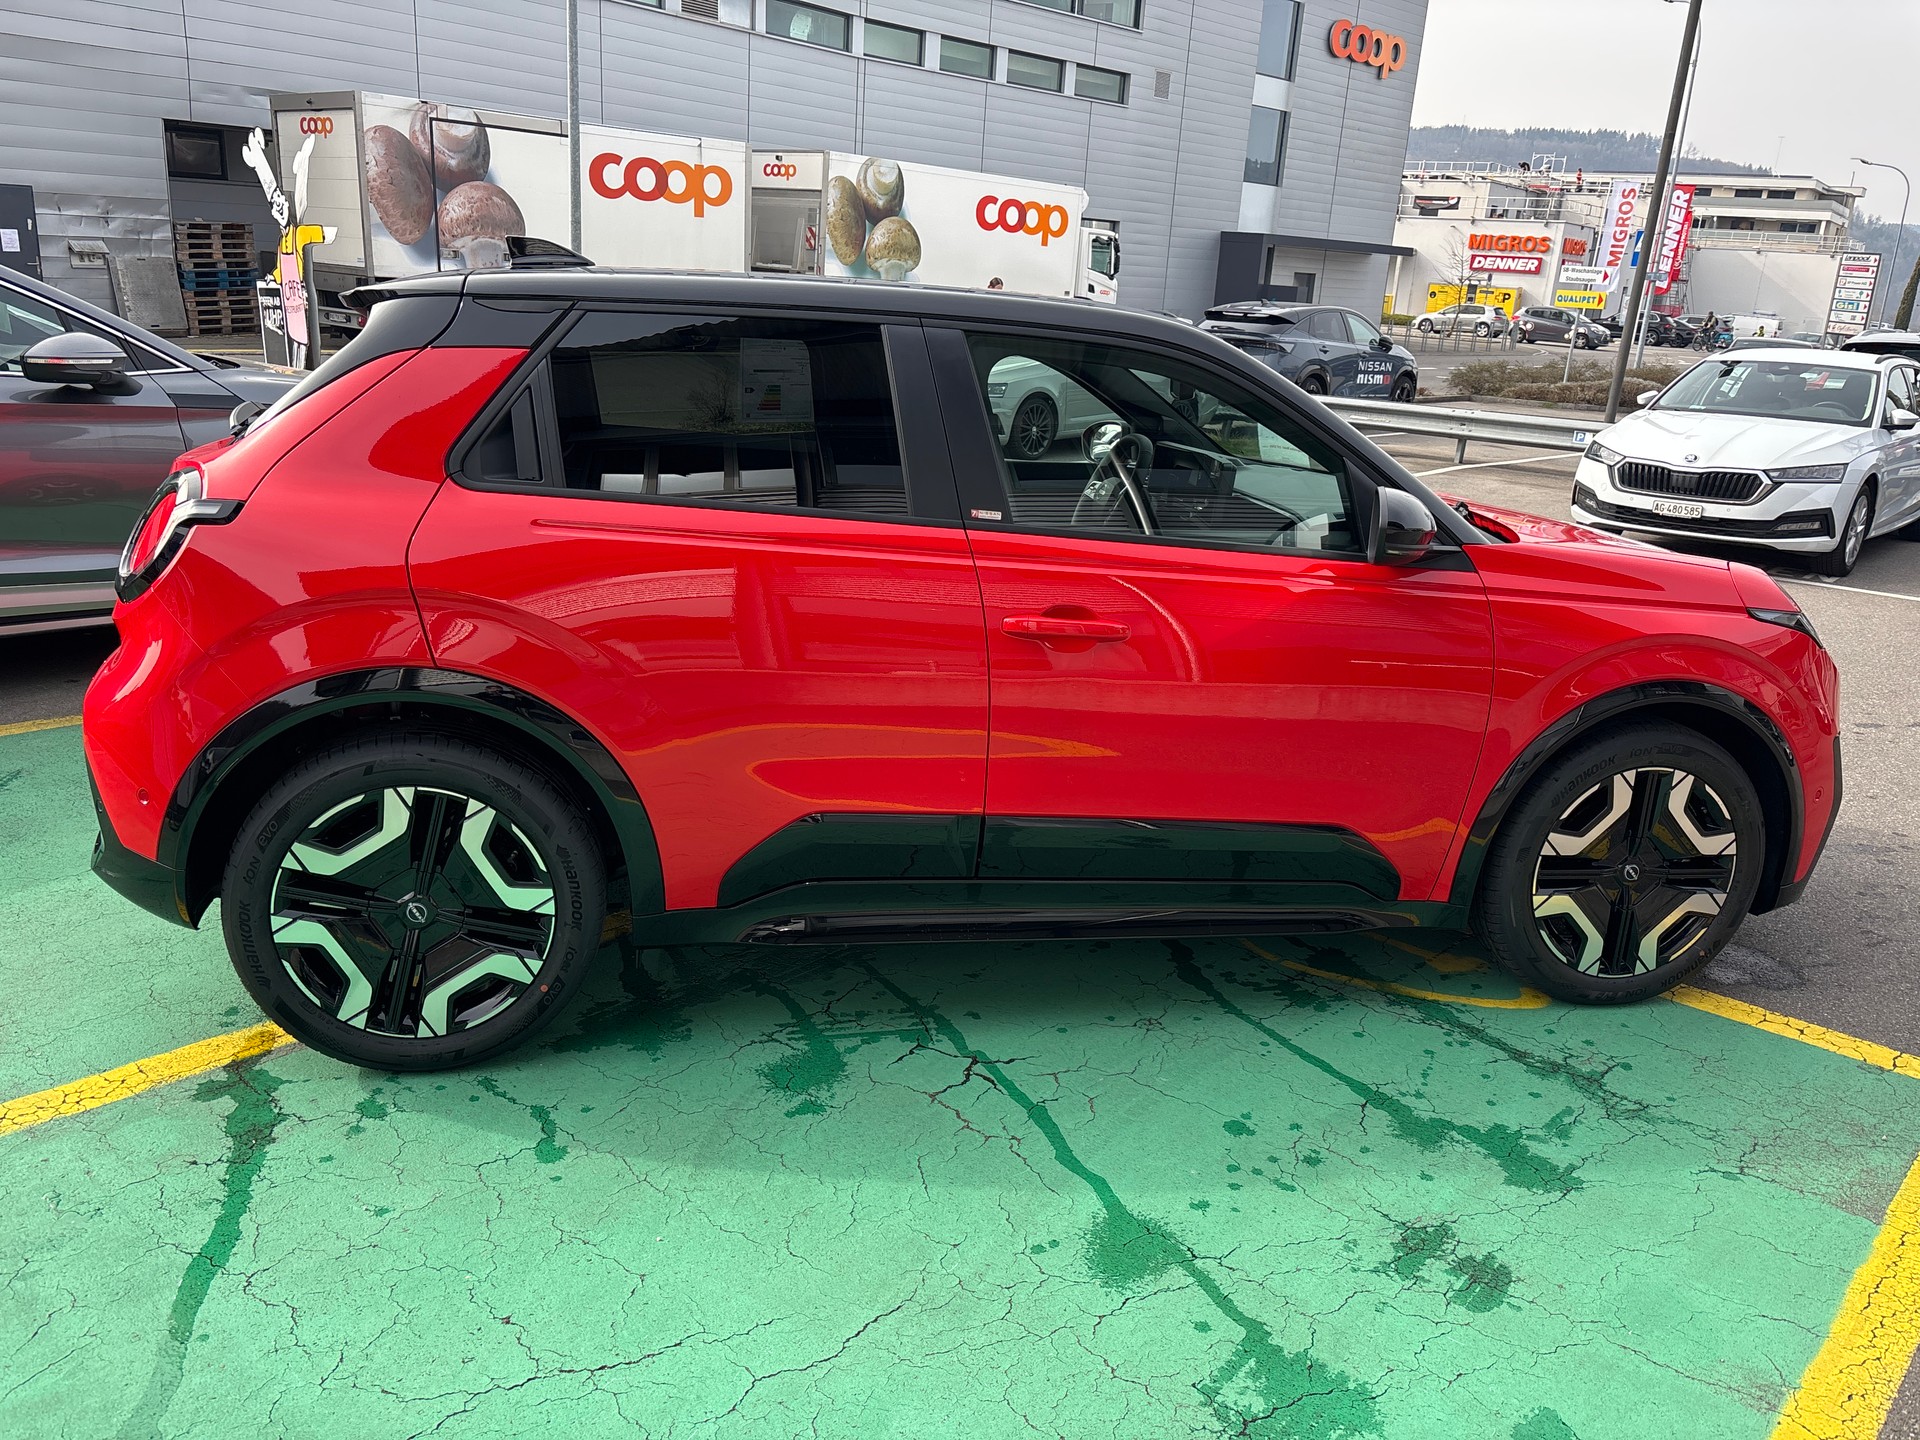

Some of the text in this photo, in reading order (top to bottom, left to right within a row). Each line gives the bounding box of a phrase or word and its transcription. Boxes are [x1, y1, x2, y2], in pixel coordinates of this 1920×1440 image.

[1329, 19, 1407, 79] coop
[300, 116, 333, 138] coop
[763, 162, 797, 181] coop
[589, 152, 733, 218] coop
[976, 195, 1069, 247] coop
[1606, 187, 1637, 267] MIGROS
[1468, 233, 1552, 254] MIGROS
[1472, 257, 1540, 272] DENNER
[1563, 267, 1603, 275] SB-Waschanlage
[1557, 294, 1597, 304] QUALIPET
[1358, 361, 1393, 372] NISSAN
